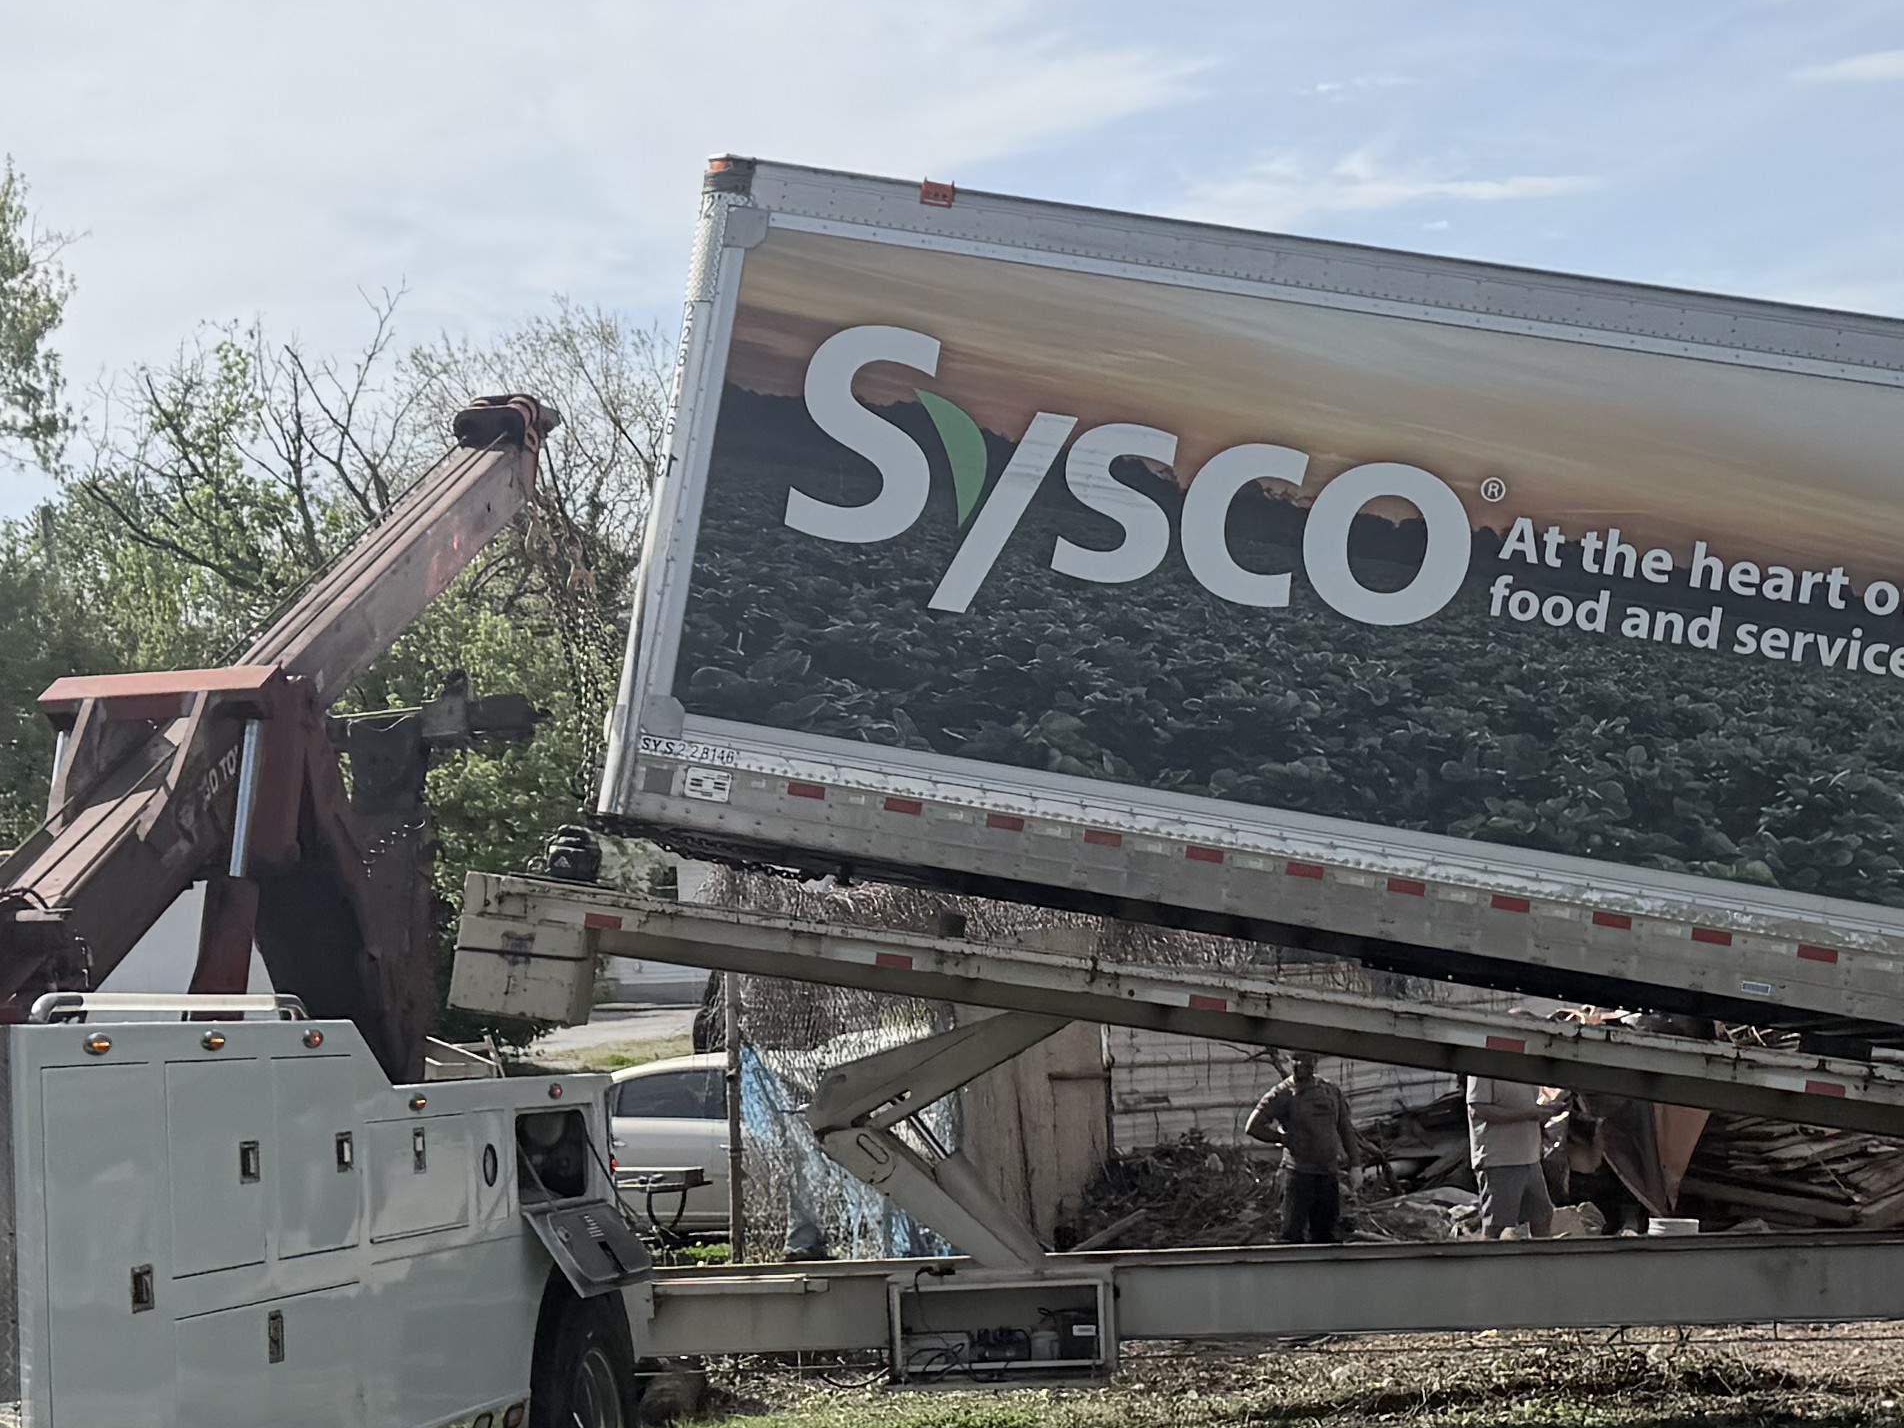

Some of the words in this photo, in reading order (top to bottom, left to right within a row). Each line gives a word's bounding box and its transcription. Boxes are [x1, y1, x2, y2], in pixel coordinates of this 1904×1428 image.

[666, 303, 695, 435] 228146
[1498, 516, 1566, 568] At
[1580, 528, 1674, 583] the
[1688, 541, 1850, 610] heart
[1489, 574, 1611, 634] food
[1620, 606, 1723, 650] and
